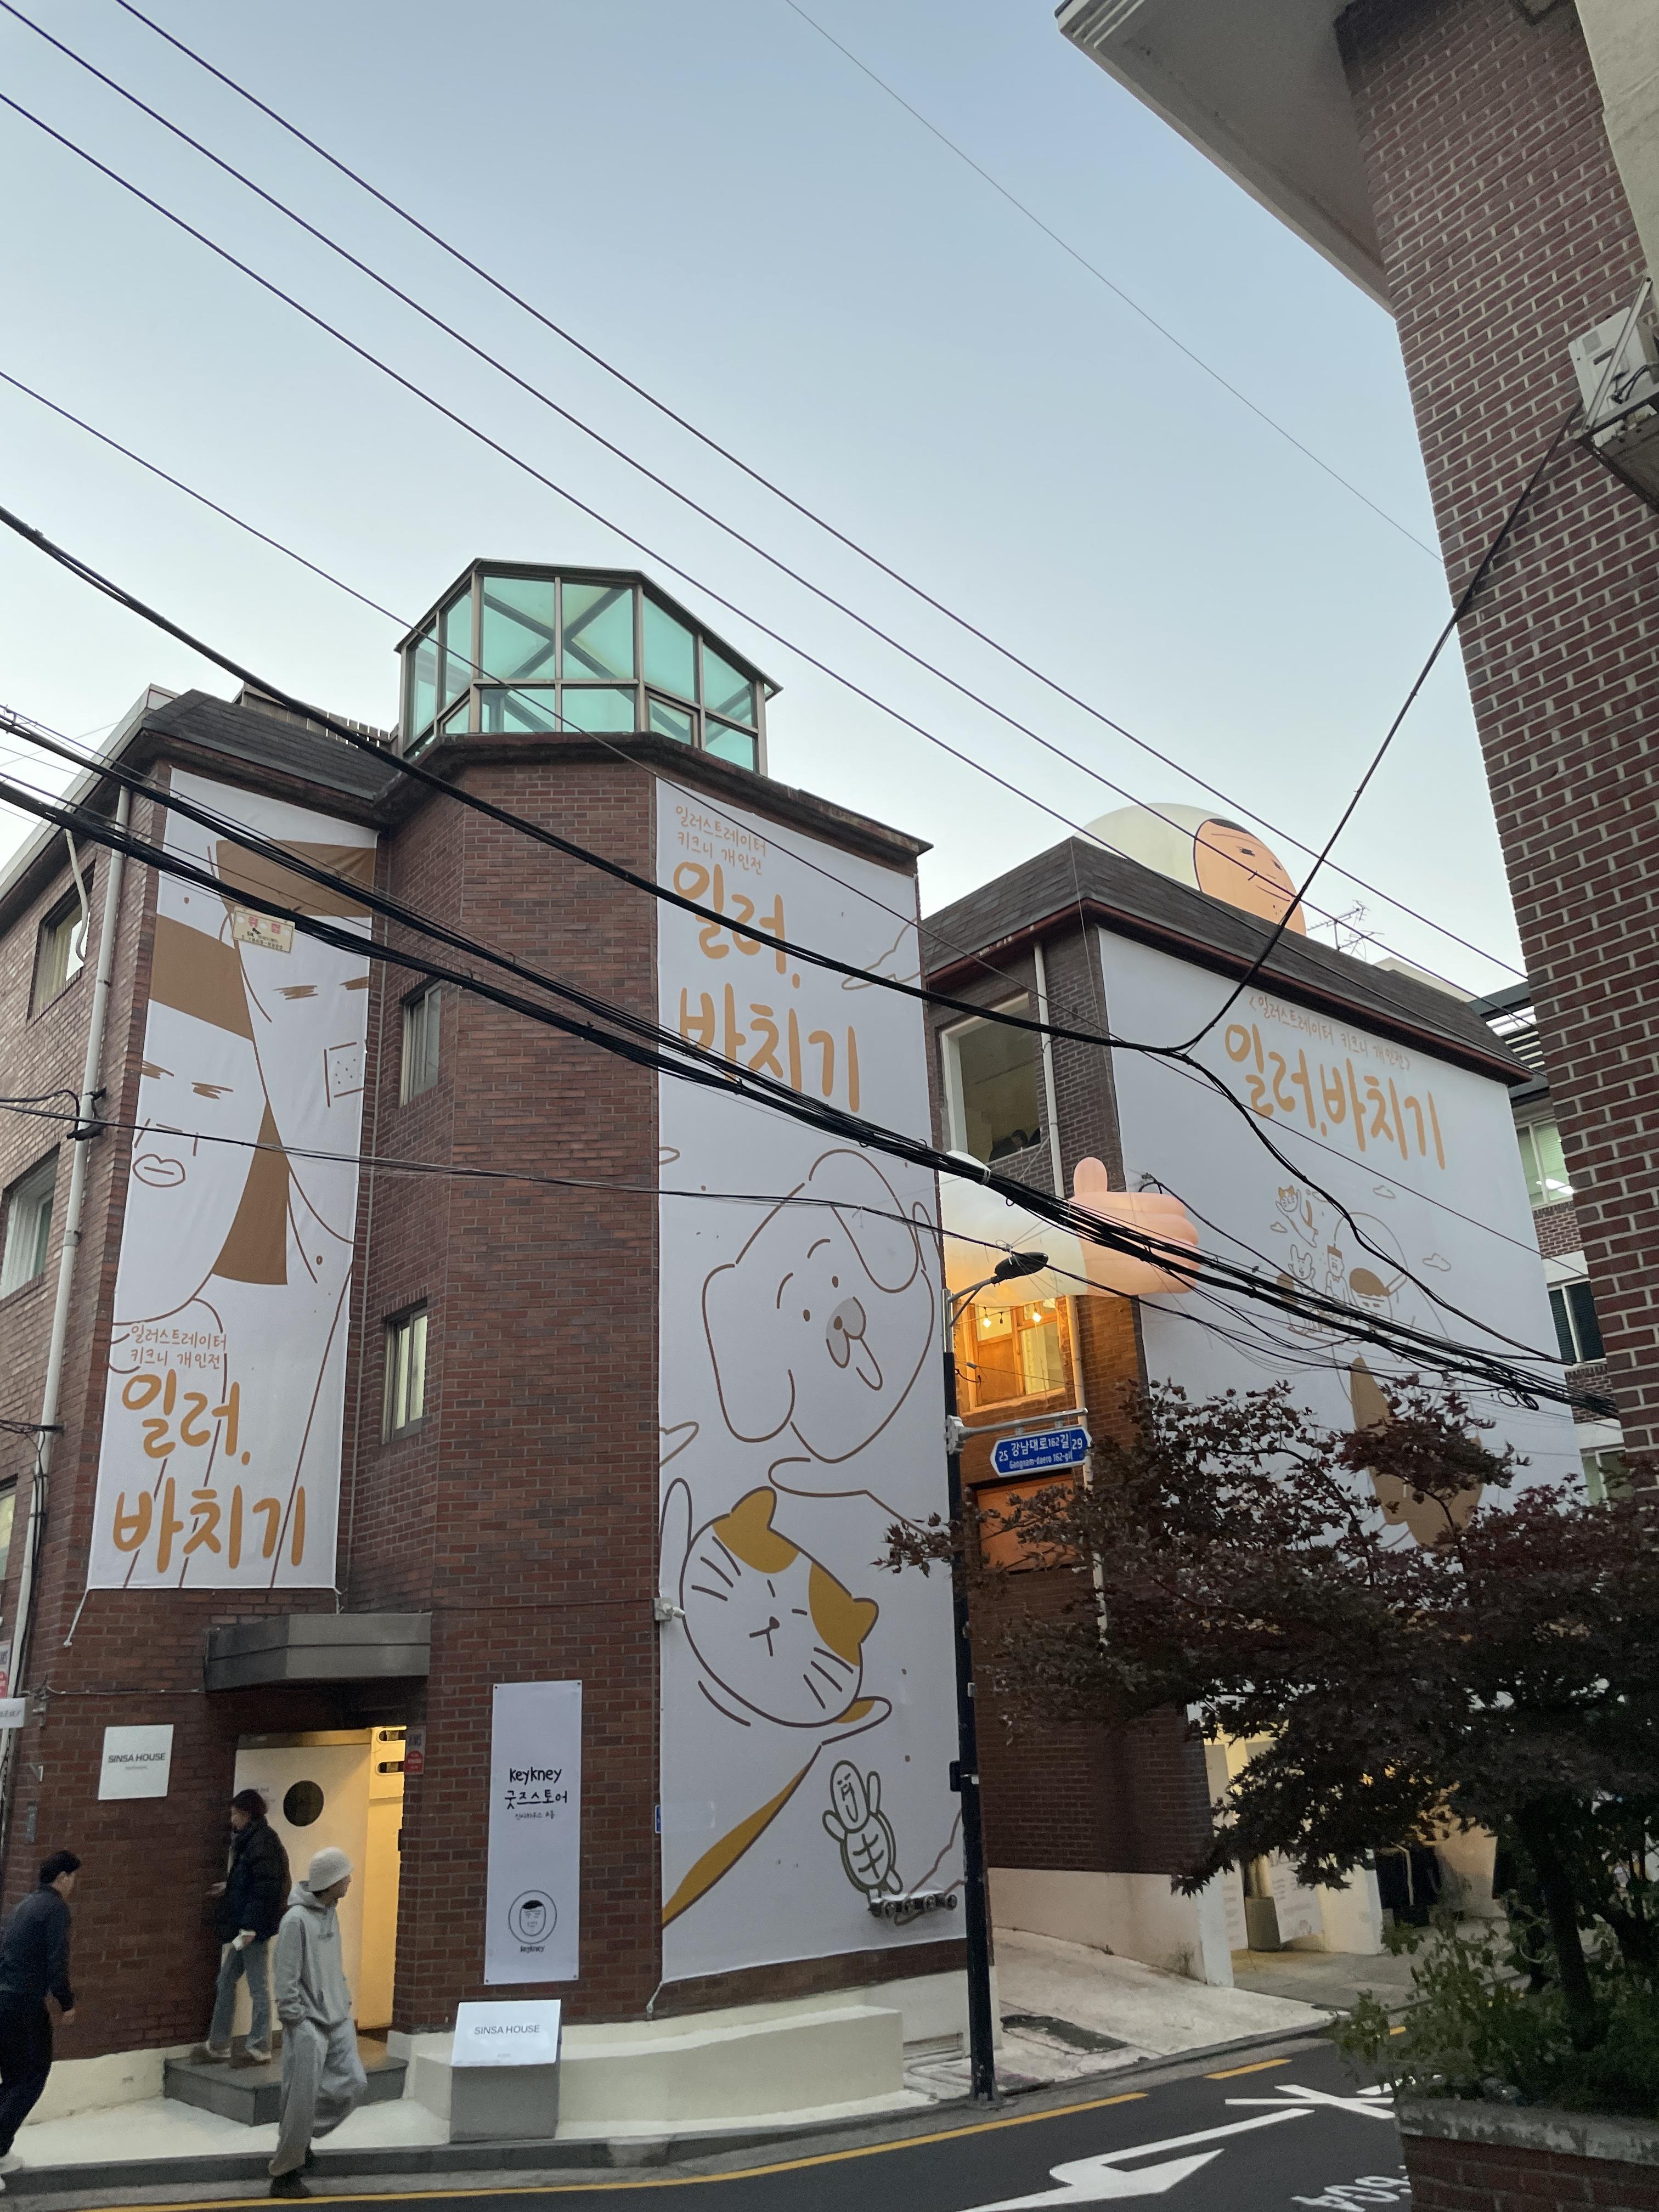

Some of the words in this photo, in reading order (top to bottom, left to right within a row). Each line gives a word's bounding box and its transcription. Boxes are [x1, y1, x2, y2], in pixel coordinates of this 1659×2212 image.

[676, 805, 766, 857] 일러스트레이터
[678, 831, 713, 859] 키크니
[721, 848, 761, 876] 개인전
[679, 983, 860, 1113] 바치기
[131, 1324, 227, 1351] 일러스트레이터
[131, 1347, 168, 1366] 키크니
[177, 1351, 220, 1369] 개인전
[998, 1450, 1008, 1462] 25
[1011, 1433, 1069, 1457] 강남대로162길
[1071, 1437, 1083, 1450] 29
[1009, 1455, 1052, 1470] Gangnam-daero
[1053, 1451, 1073, 1462] 162-gil
[113, 1477, 306, 1573] 바치기
[108, 1753, 134, 1763] SINSA
[135, 1752, 166, 1762] HOUSE
[504, 1790, 567, 1810] 굿즈스토어
[474, 2025, 504, 2035] SINSA
[505, 2024, 540, 2034] HOUSE
